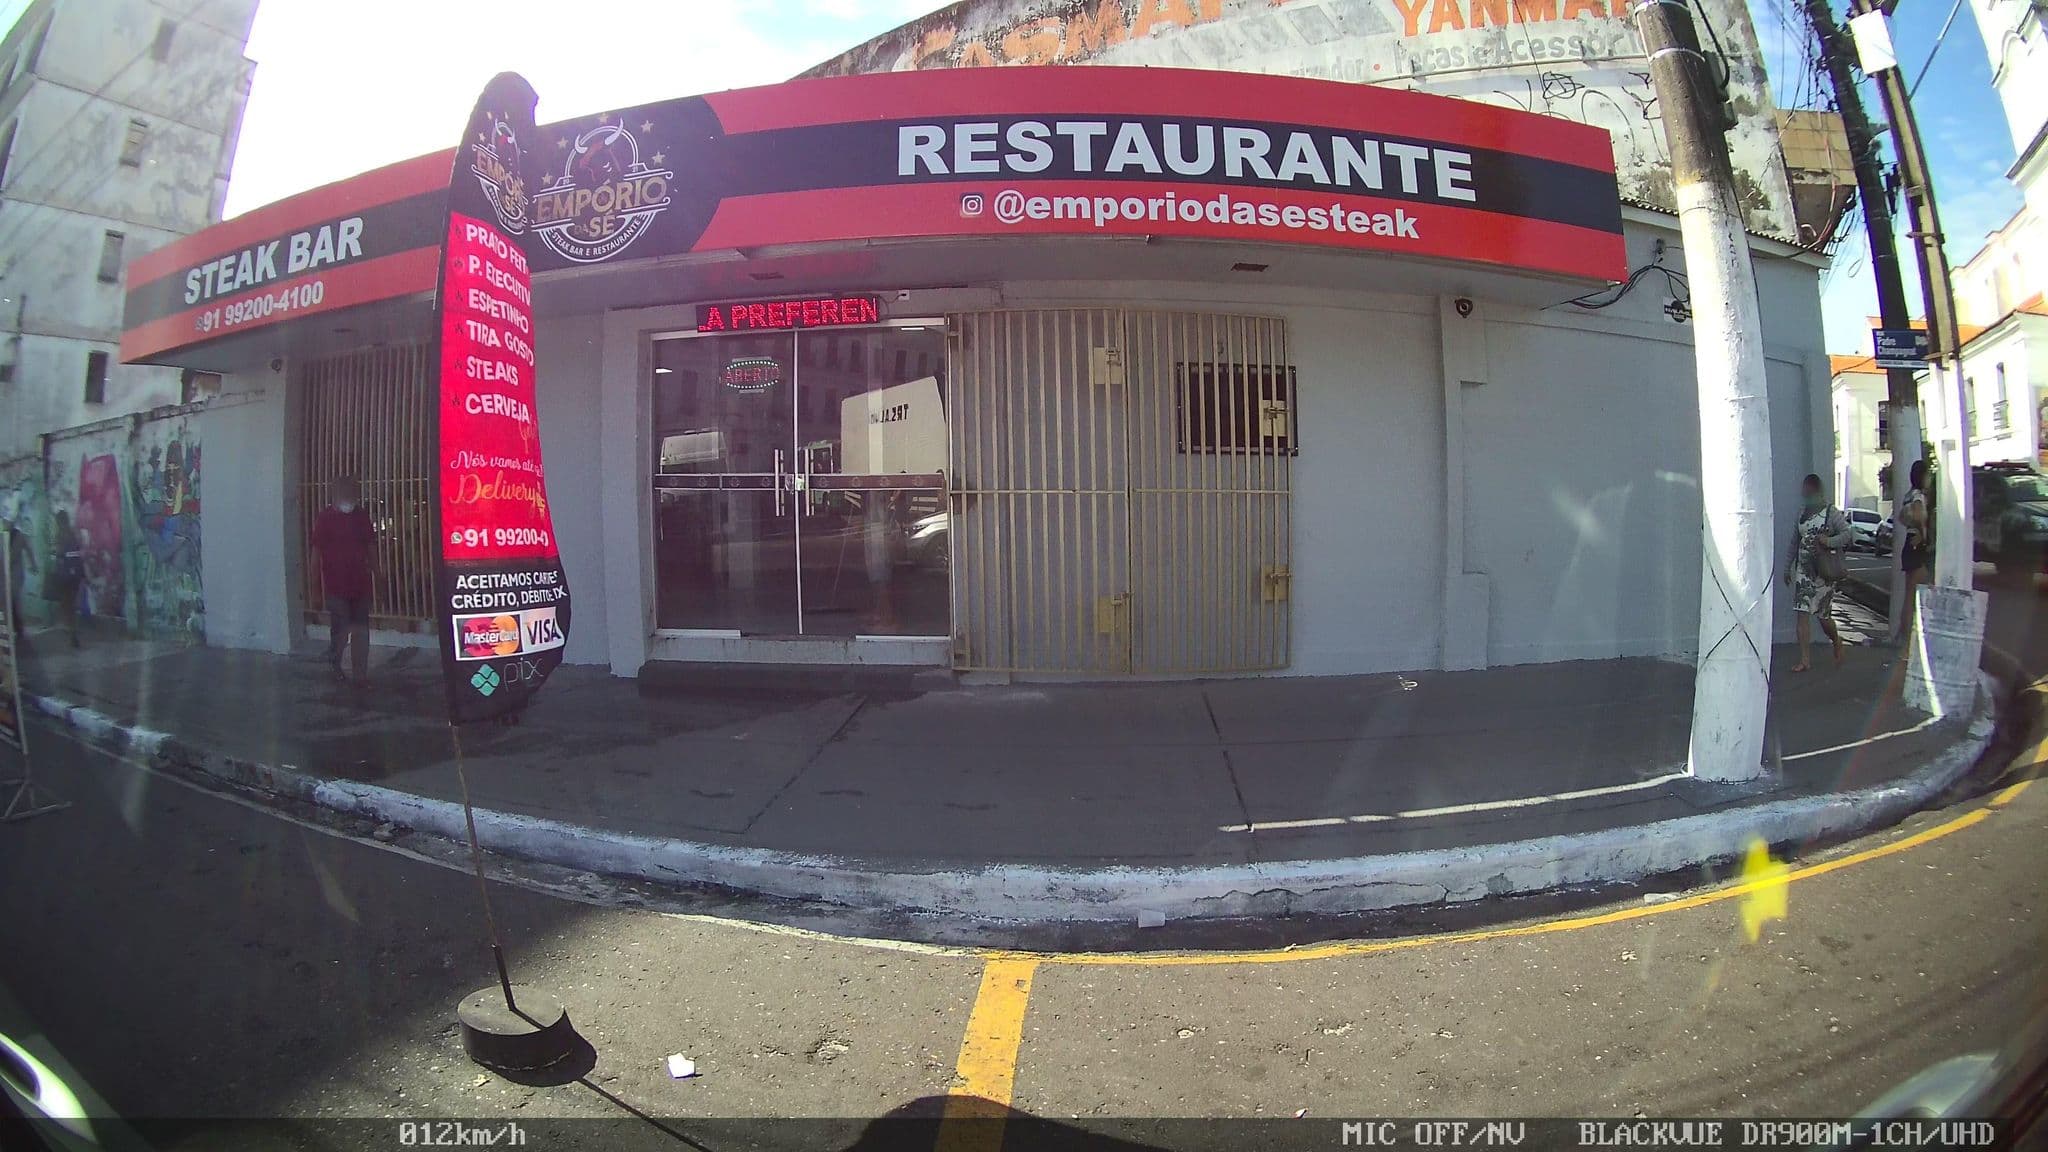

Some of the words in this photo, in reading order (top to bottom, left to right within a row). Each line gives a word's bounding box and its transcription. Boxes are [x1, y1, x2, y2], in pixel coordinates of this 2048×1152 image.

[898, 121, 1477, 202] RESTAURANTE
[536, 176, 668, 223] EMPÓRIO
[993, 189, 1420, 239] @emporiodasesteak
[551, 231, 570, 251] STEAK
[569, 244, 584, 256] BAR
[585, 247, 591, 256] E
[592, 218, 642, 256] RESTAURANTE
[590, 211, 617, 237] SÉ
[184, 240, 281, 305] STEAK
[287, 217, 364, 274] BAR
[465, 223, 508, 260] PRATO
[509, 245, 530, 275] FEIT
[468, 255, 483, 277] P.
[203, 308, 220, 332] 91
[225, 280, 325, 327] 99200-4100
[468, 288, 529, 334] ESPETINHO
[731, 297, 877, 328] PREFEREN
[466, 320, 501, 348] TIRA
[504, 331, 534, 367] GOSTO
[466, 355, 519, 387] STEAKS
[465, 393, 530, 424] CERVEJA
[450, 450, 488, 469] Nós
[489, 456, 521, 470] vamos
[449, 469, 537, 519] Delivery
[464, 528, 488, 547] 91
[456, 571, 532, 590] ACEITAMOS
[451, 589, 520, 609] CRÉDITO,
[464, 629, 519, 645] MasterCard
[527, 617, 561, 645] VISA
[503, 657, 543, 692] pix
